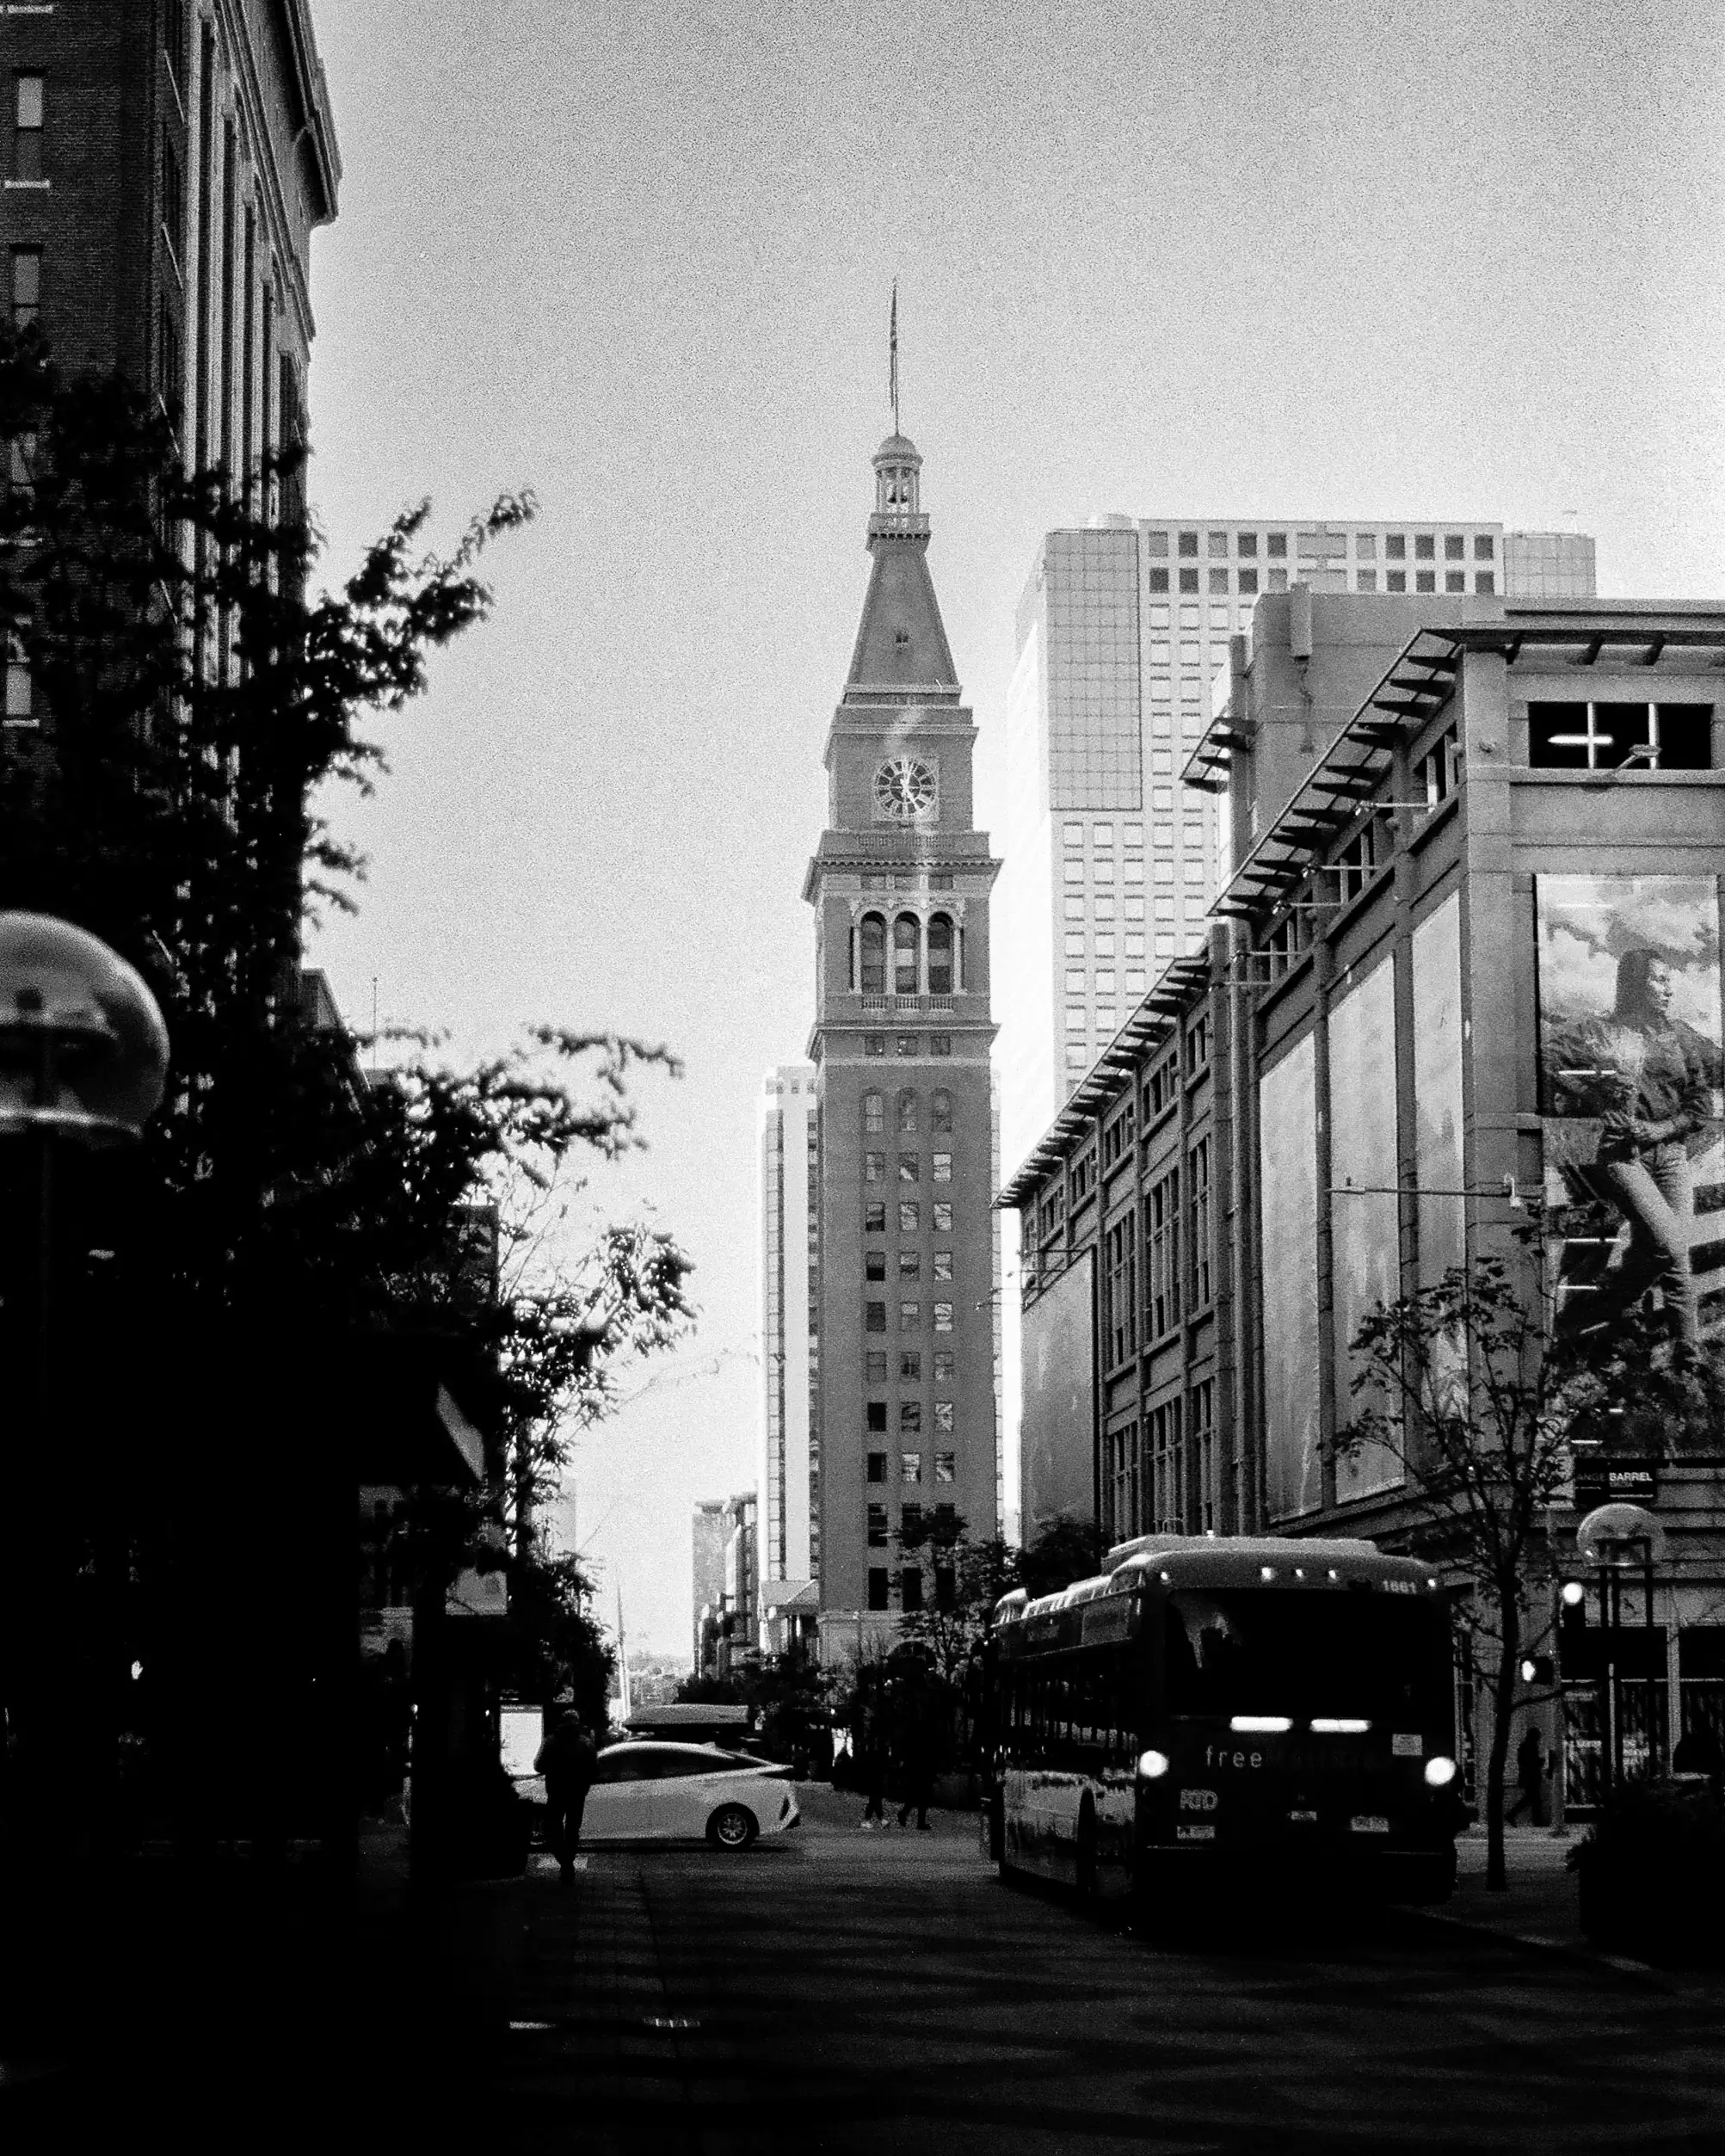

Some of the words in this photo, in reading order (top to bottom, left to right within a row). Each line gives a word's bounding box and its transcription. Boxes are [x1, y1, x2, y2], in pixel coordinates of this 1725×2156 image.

[1608, 1471, 1653, 1481] BARREL
[1206, 1745, 1263, 1768] free
[1180, 1788, 1219, 1811] RTD
